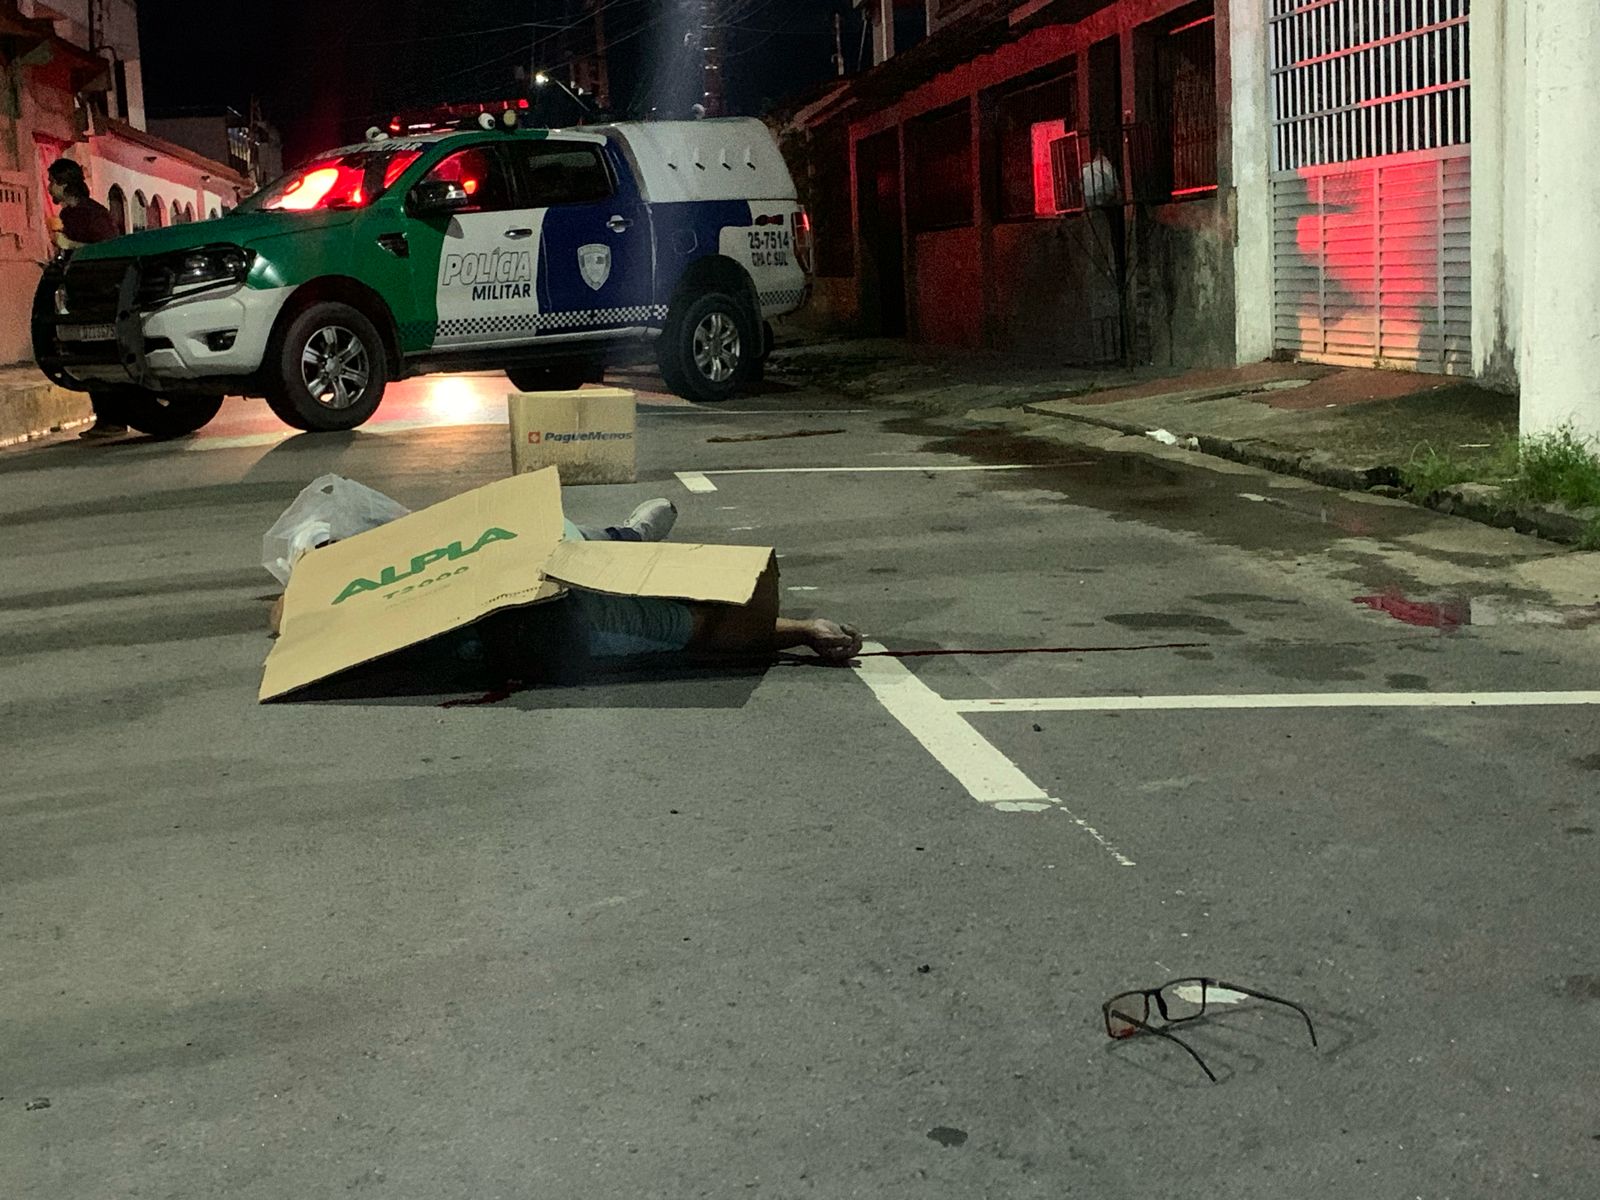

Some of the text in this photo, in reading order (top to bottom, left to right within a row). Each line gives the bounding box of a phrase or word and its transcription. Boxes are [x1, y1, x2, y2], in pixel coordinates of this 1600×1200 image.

[748, 230, 791, 249] 25-7514
[442, 247, 532, 286] POLÍCIA
[472, 283, 531, 301] MILITAR
[330, 527, 519, 606] ALPLA
